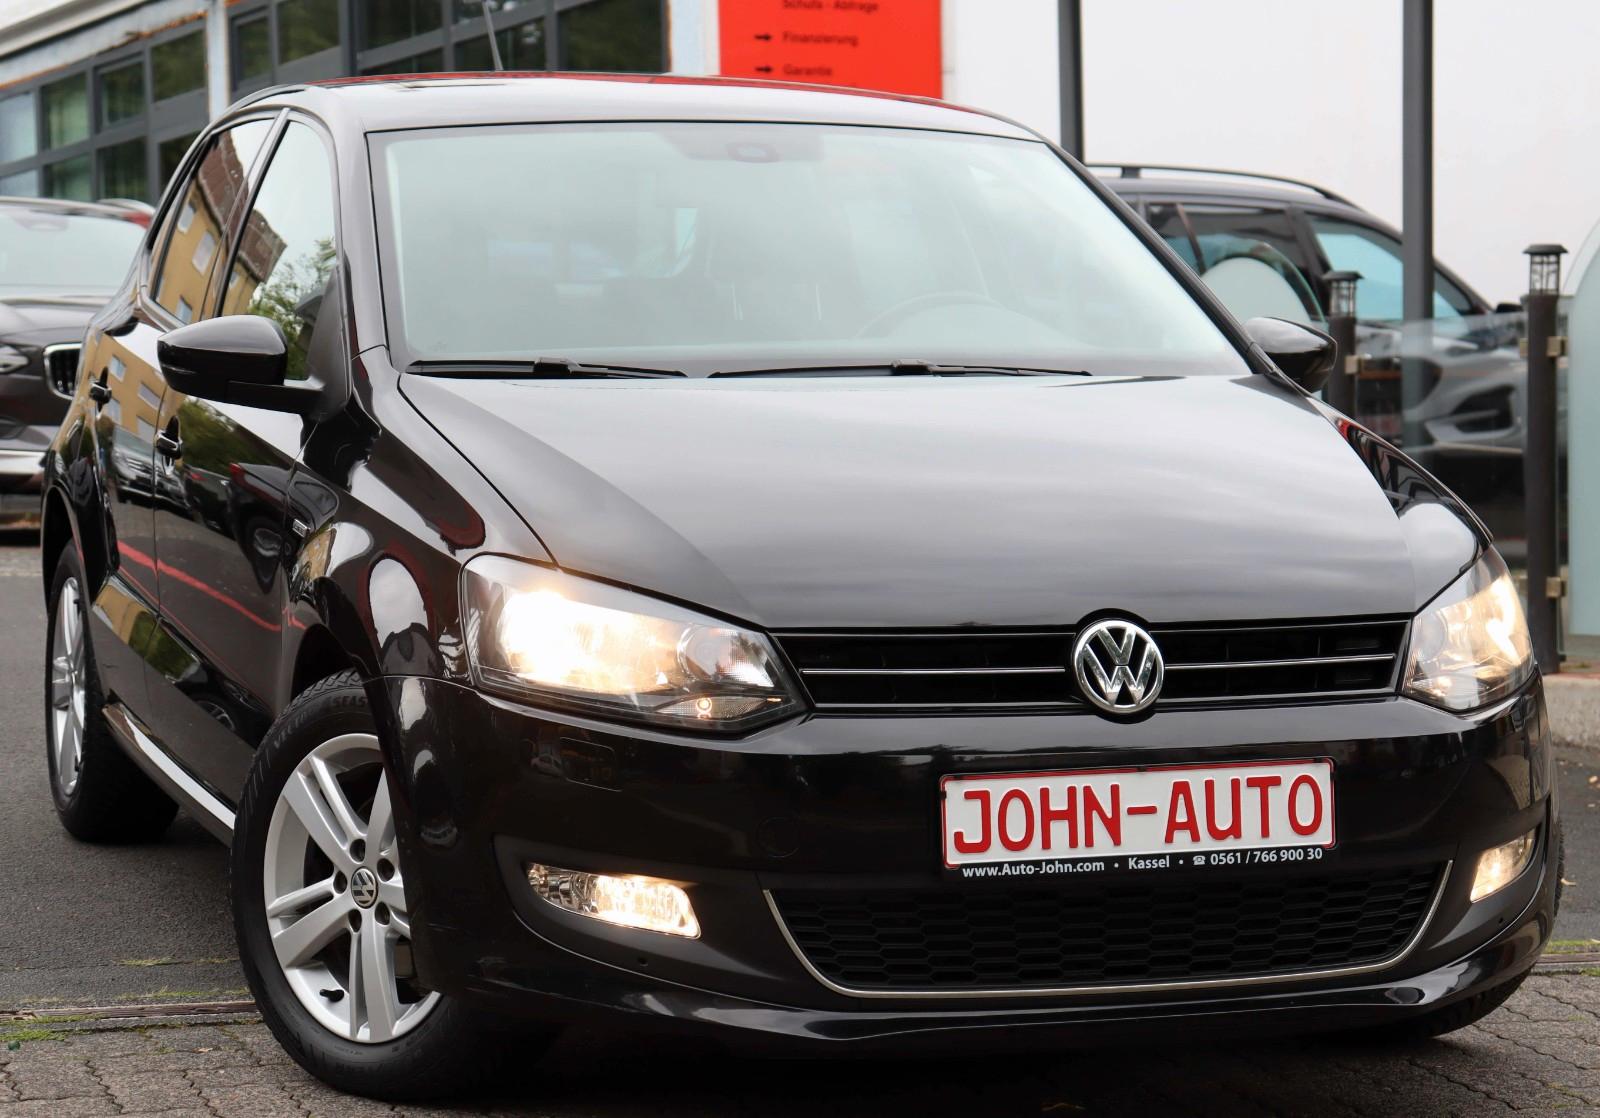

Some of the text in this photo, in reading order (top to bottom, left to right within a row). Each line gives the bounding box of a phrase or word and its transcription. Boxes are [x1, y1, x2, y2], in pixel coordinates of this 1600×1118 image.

[782, 31, 859, 48] Finanzierung
[783, 64, 833, 77] Garantie
[1075, 619, 1165, 714] VW
[953, 773, 1323, 853] JOHN-AUTO
[962, 859, 1105, 878] www.Auto-John.com
[1128, 855, 1170, 869] Kassel
[1210, 852, 1242, 865] 0561
[1253, 849, 1278, 863] 766
[1280, 848, 1304, 861] 900
[1307, 847, 1323, 860] 30
